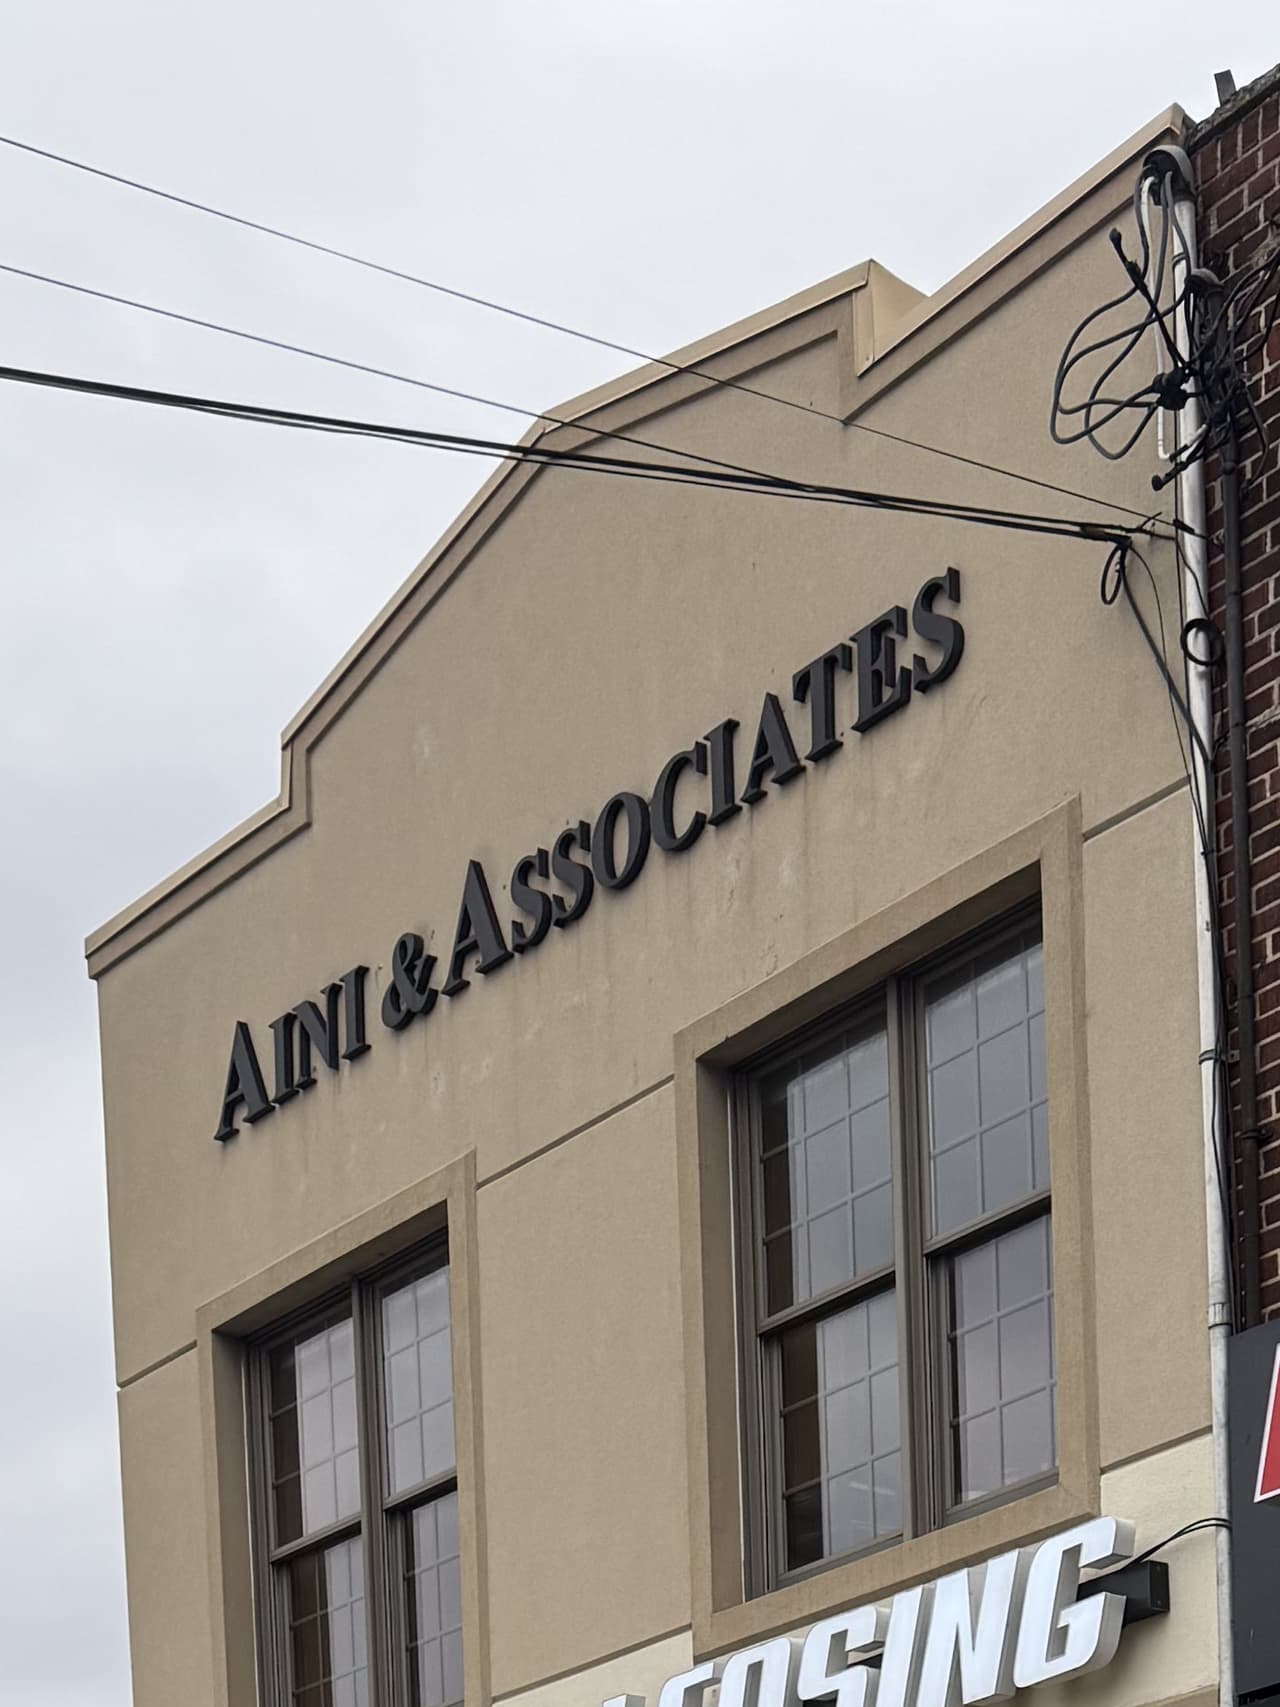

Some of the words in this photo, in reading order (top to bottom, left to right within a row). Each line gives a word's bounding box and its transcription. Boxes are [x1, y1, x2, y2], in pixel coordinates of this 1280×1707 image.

[214, 964, 371, 1142] AINI
[381, 932, 438, 1031] &
[442, 567, 964, 998] ASSOCIATES
